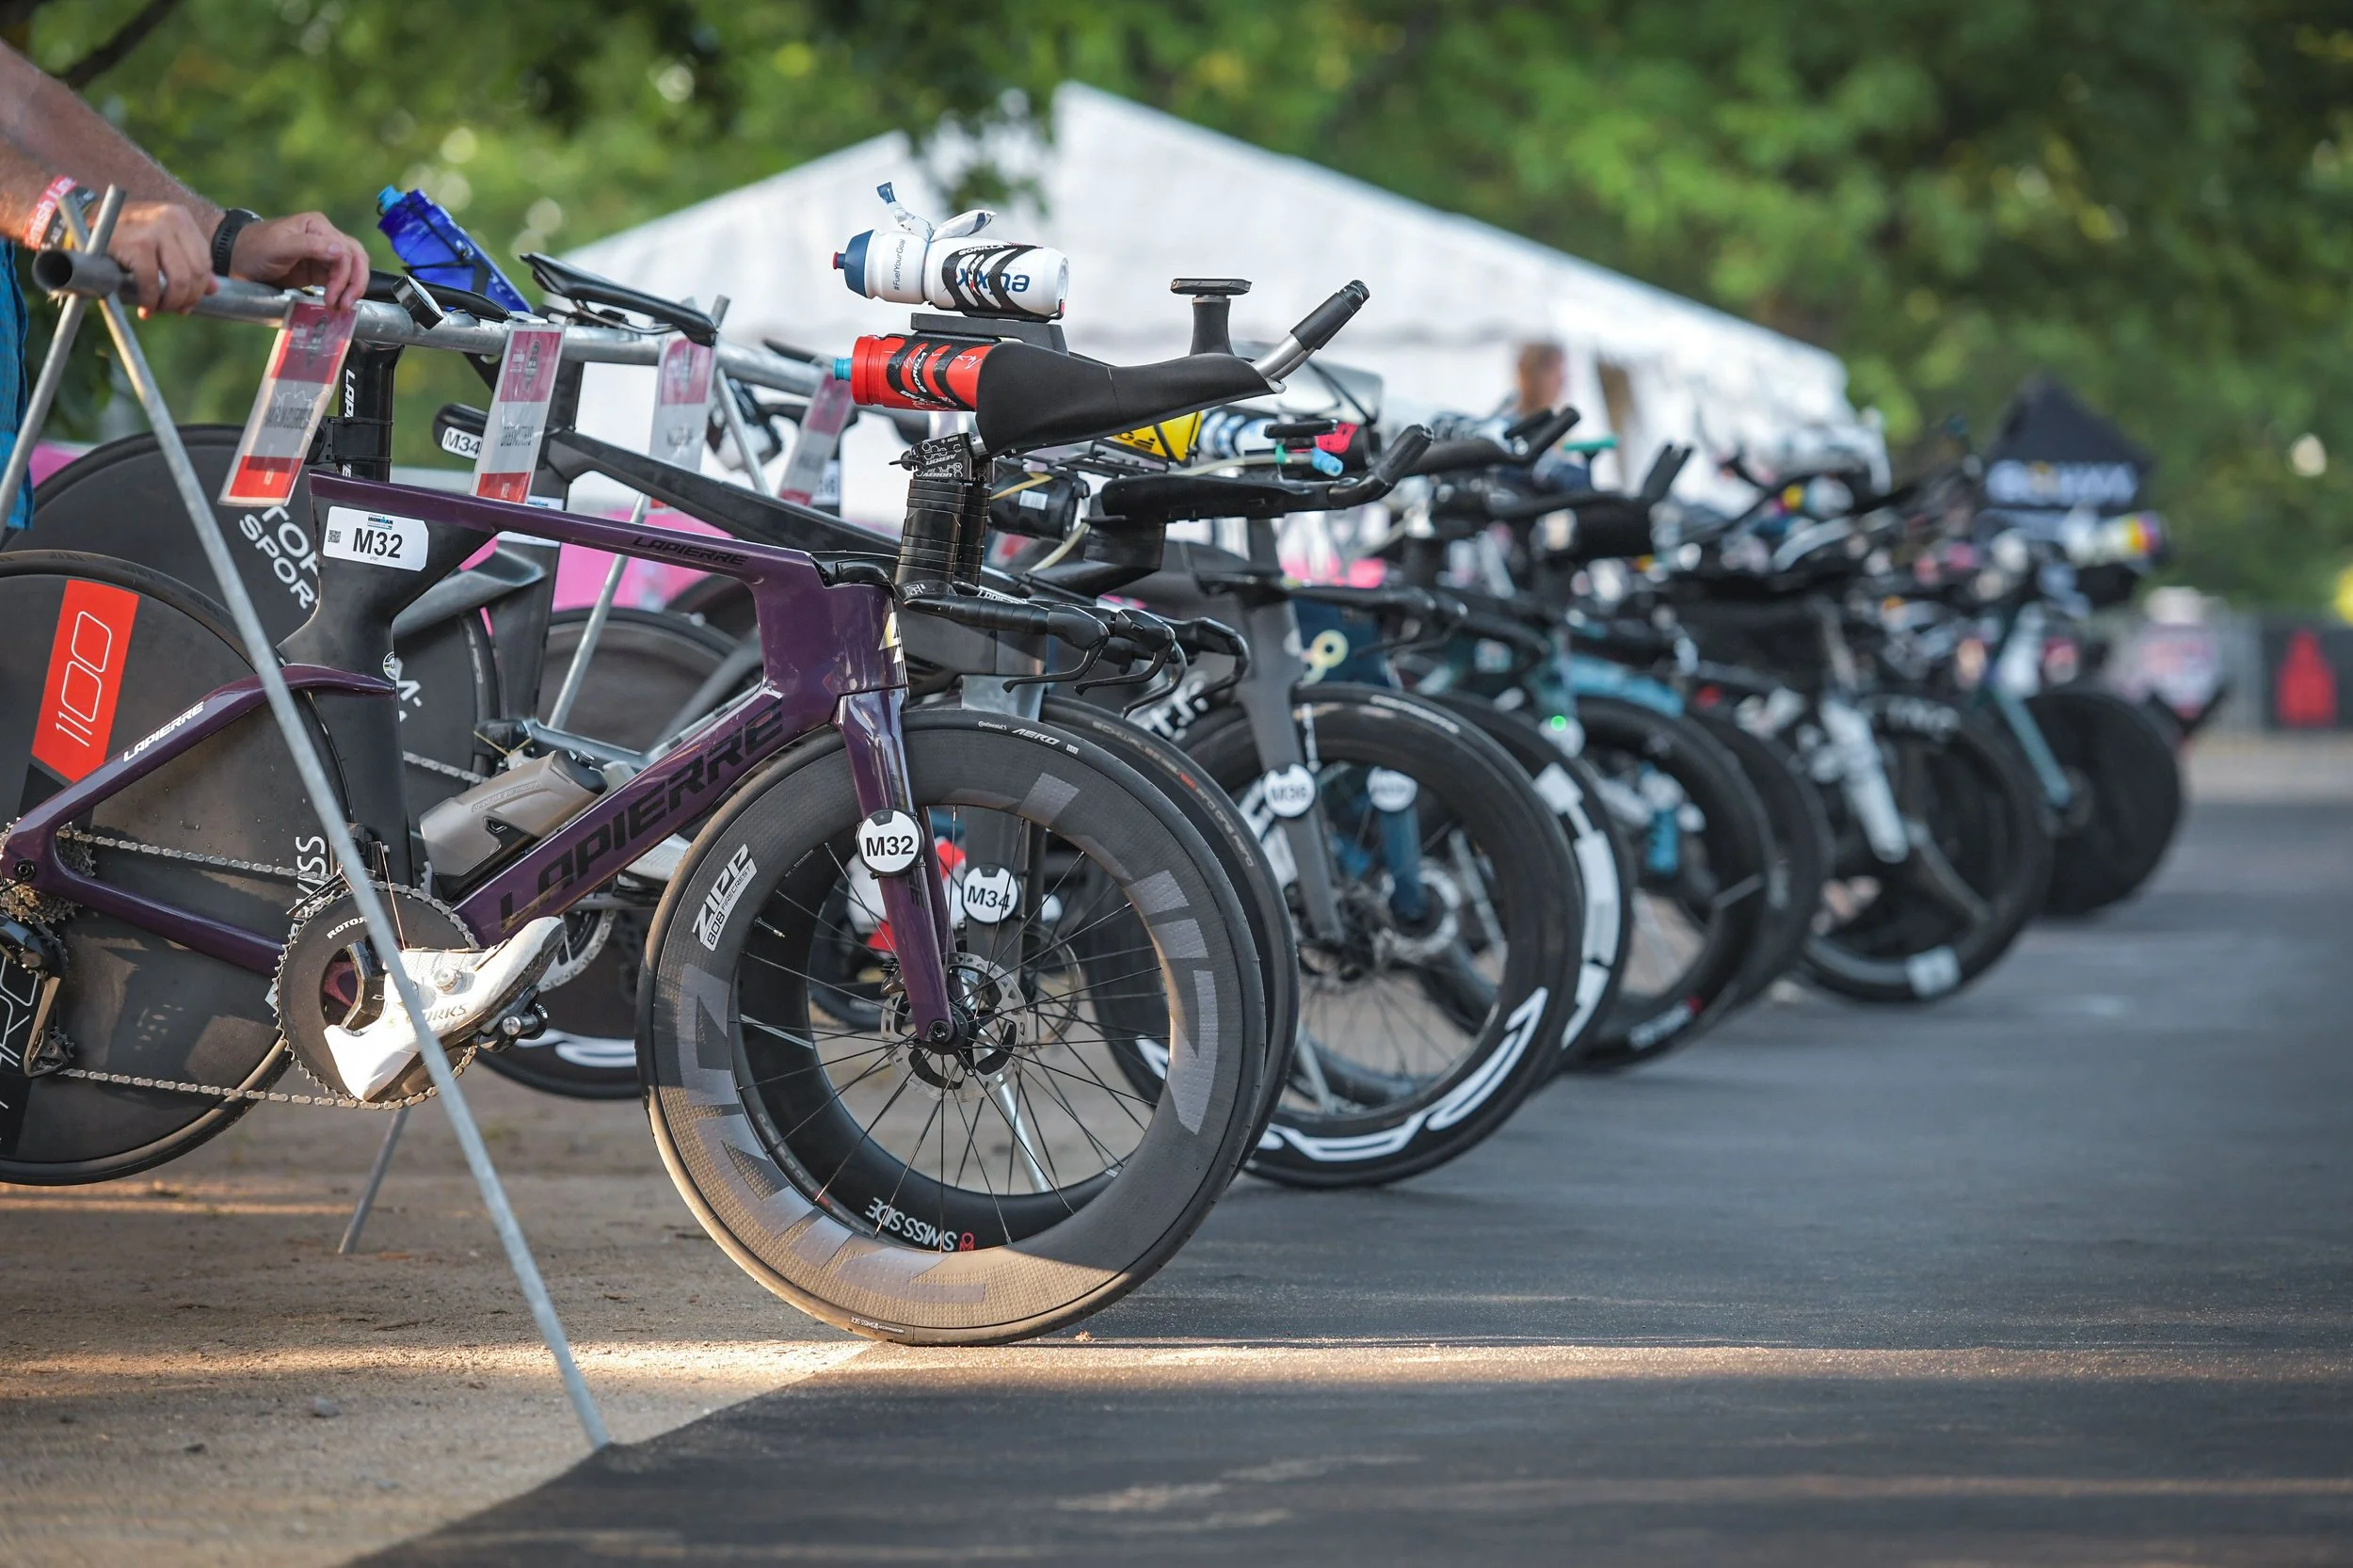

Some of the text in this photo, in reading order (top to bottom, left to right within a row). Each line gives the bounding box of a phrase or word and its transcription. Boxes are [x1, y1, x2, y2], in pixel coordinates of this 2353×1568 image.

[893, 237, 906, 291] #FuelYourGoal
[958, 244, 1004, 256] GORILLA
[444, 431, 481, 455] M34
[352, 527, 403, 559] M32
[632, 536, 749, 565] LAPIERRE
[239, 513, 319, 609] SPOR
[123, 700, 204, 762] LAPIERRE
[1012, 728, 1061, 745] AERO
[499, 696, 784, 927] LAPIERRE
[865, 835, 914, 856] M32
[691, 843, 749, 944] ZIPP
[707, 865, 751, 945] 808 FIRECREST
[967, 885, 1010, 911] M34
[865, 1196, 905, 1231] SIDE
[903, 1217, 958, 1252] SWISS
